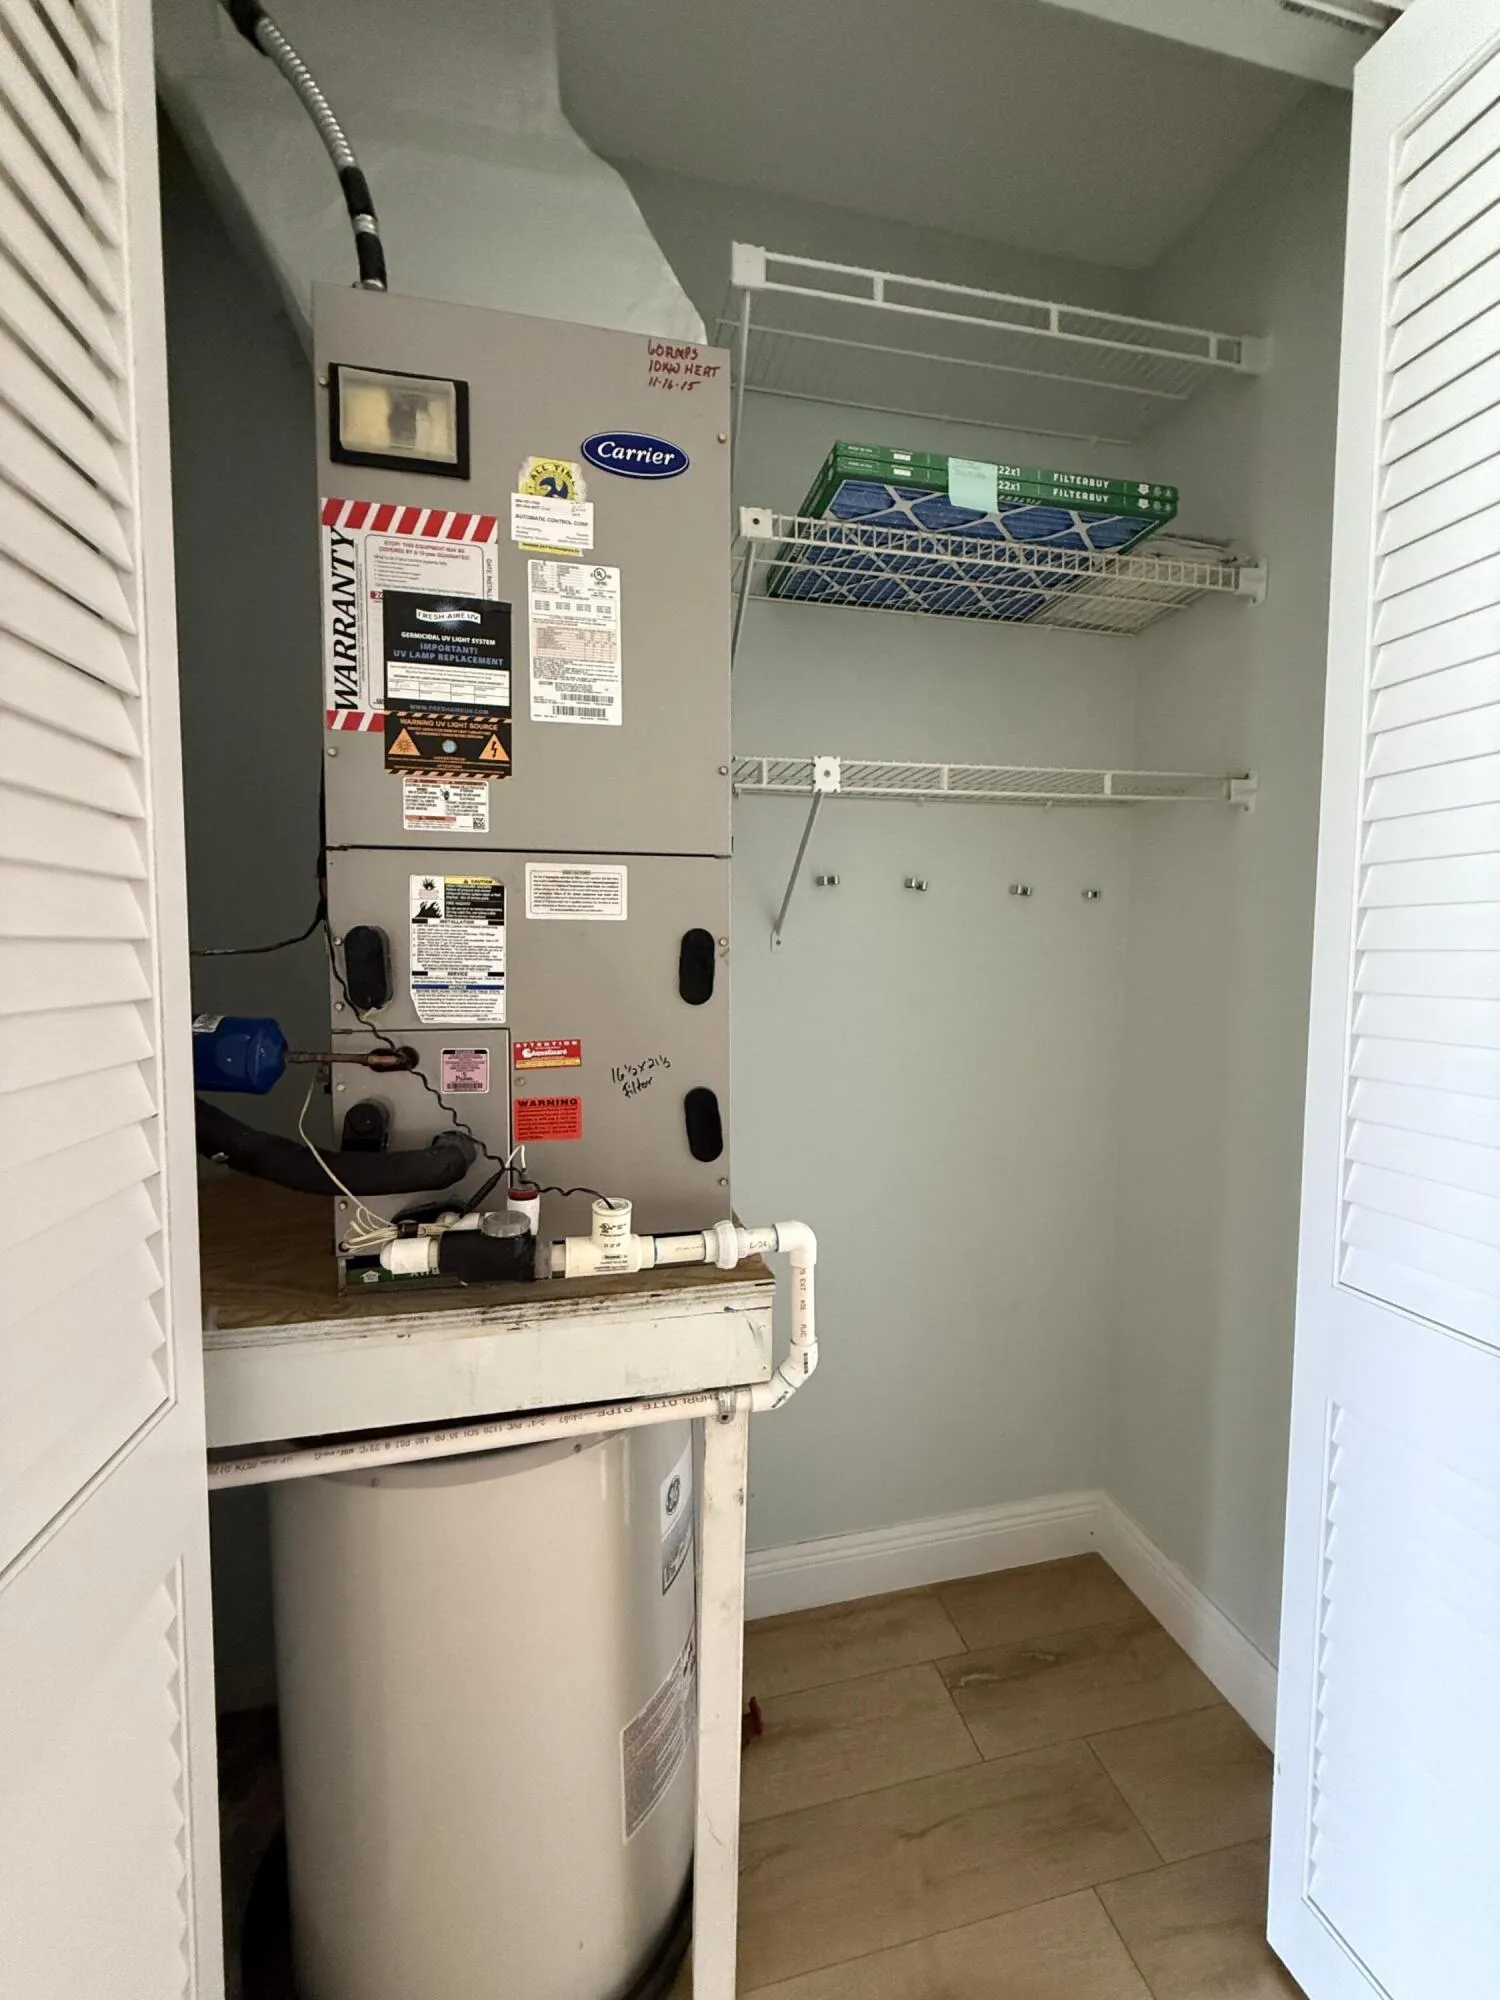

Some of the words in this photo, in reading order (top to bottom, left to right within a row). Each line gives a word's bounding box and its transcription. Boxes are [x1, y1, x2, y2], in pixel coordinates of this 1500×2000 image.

[684, 364, 721, 378] HEAT
[597, 441, 676, 466] Carrier
[1053, 472, 1111, 489] FILTERBUY
[1053, 487, 1111, 503] FILTERBUY
[515, 513, 546, 523] AUTOMATIC
[547, 517, 572, 526] CONTROL
[379, 546, 405, 554] COVERED
[415, 543, 445, 552] EQUIPMENT
[330, 525, 359, 711] WARRANTY
[417, 611, 445, 620] FRESH
[447, 611, 466, 620] AIRE
[467, 612, 479, 621] UV
[401, 631, 440, 641] GERMICIDAL
[452, 635, 471, 643] LIGHT
[471, 638, 496, 646] SYSTEM
[393, 649, 407, 658] UV
[409, 650, 436, 660] LAMP
[437, 652, 505, 666] REPLACEMENT
[400, 718, 435, 727] WARNING
[435, 720, 447, 728] UV
[469, 723, 499, 731] SOURCE
[516, 1040, 578, 1049] ATTENTION
[518, 1098, 578, 1107] WARNING
[596, 1404, 634, 1418] PIPE
